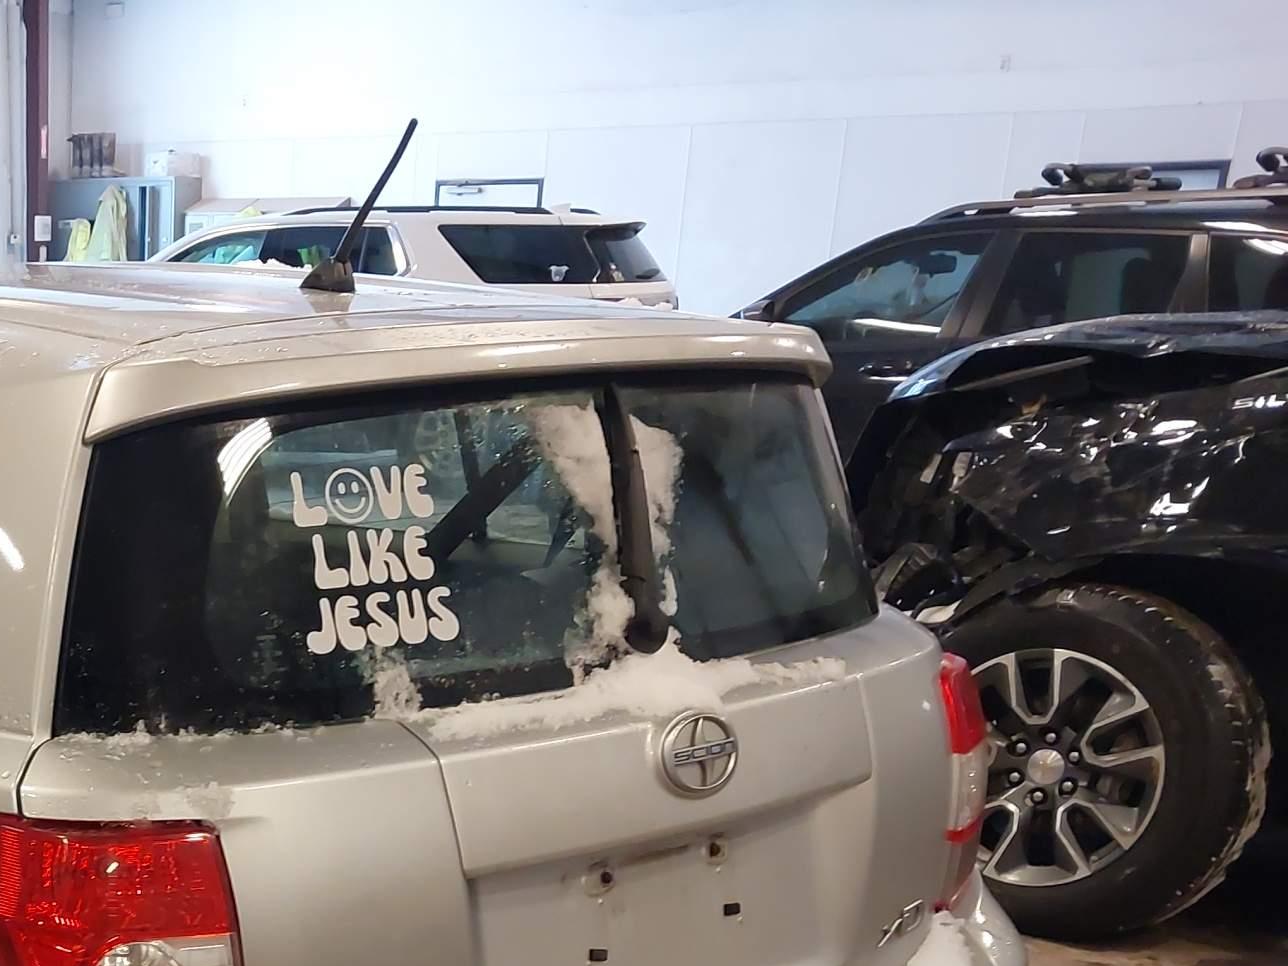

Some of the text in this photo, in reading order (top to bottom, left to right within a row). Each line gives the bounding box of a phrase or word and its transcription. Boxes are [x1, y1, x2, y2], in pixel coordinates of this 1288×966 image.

[1232, 394, 1288, 410] SIL
[312, 525, 435, 590] LIKE
[306, 586, 460, 655] JESUS
